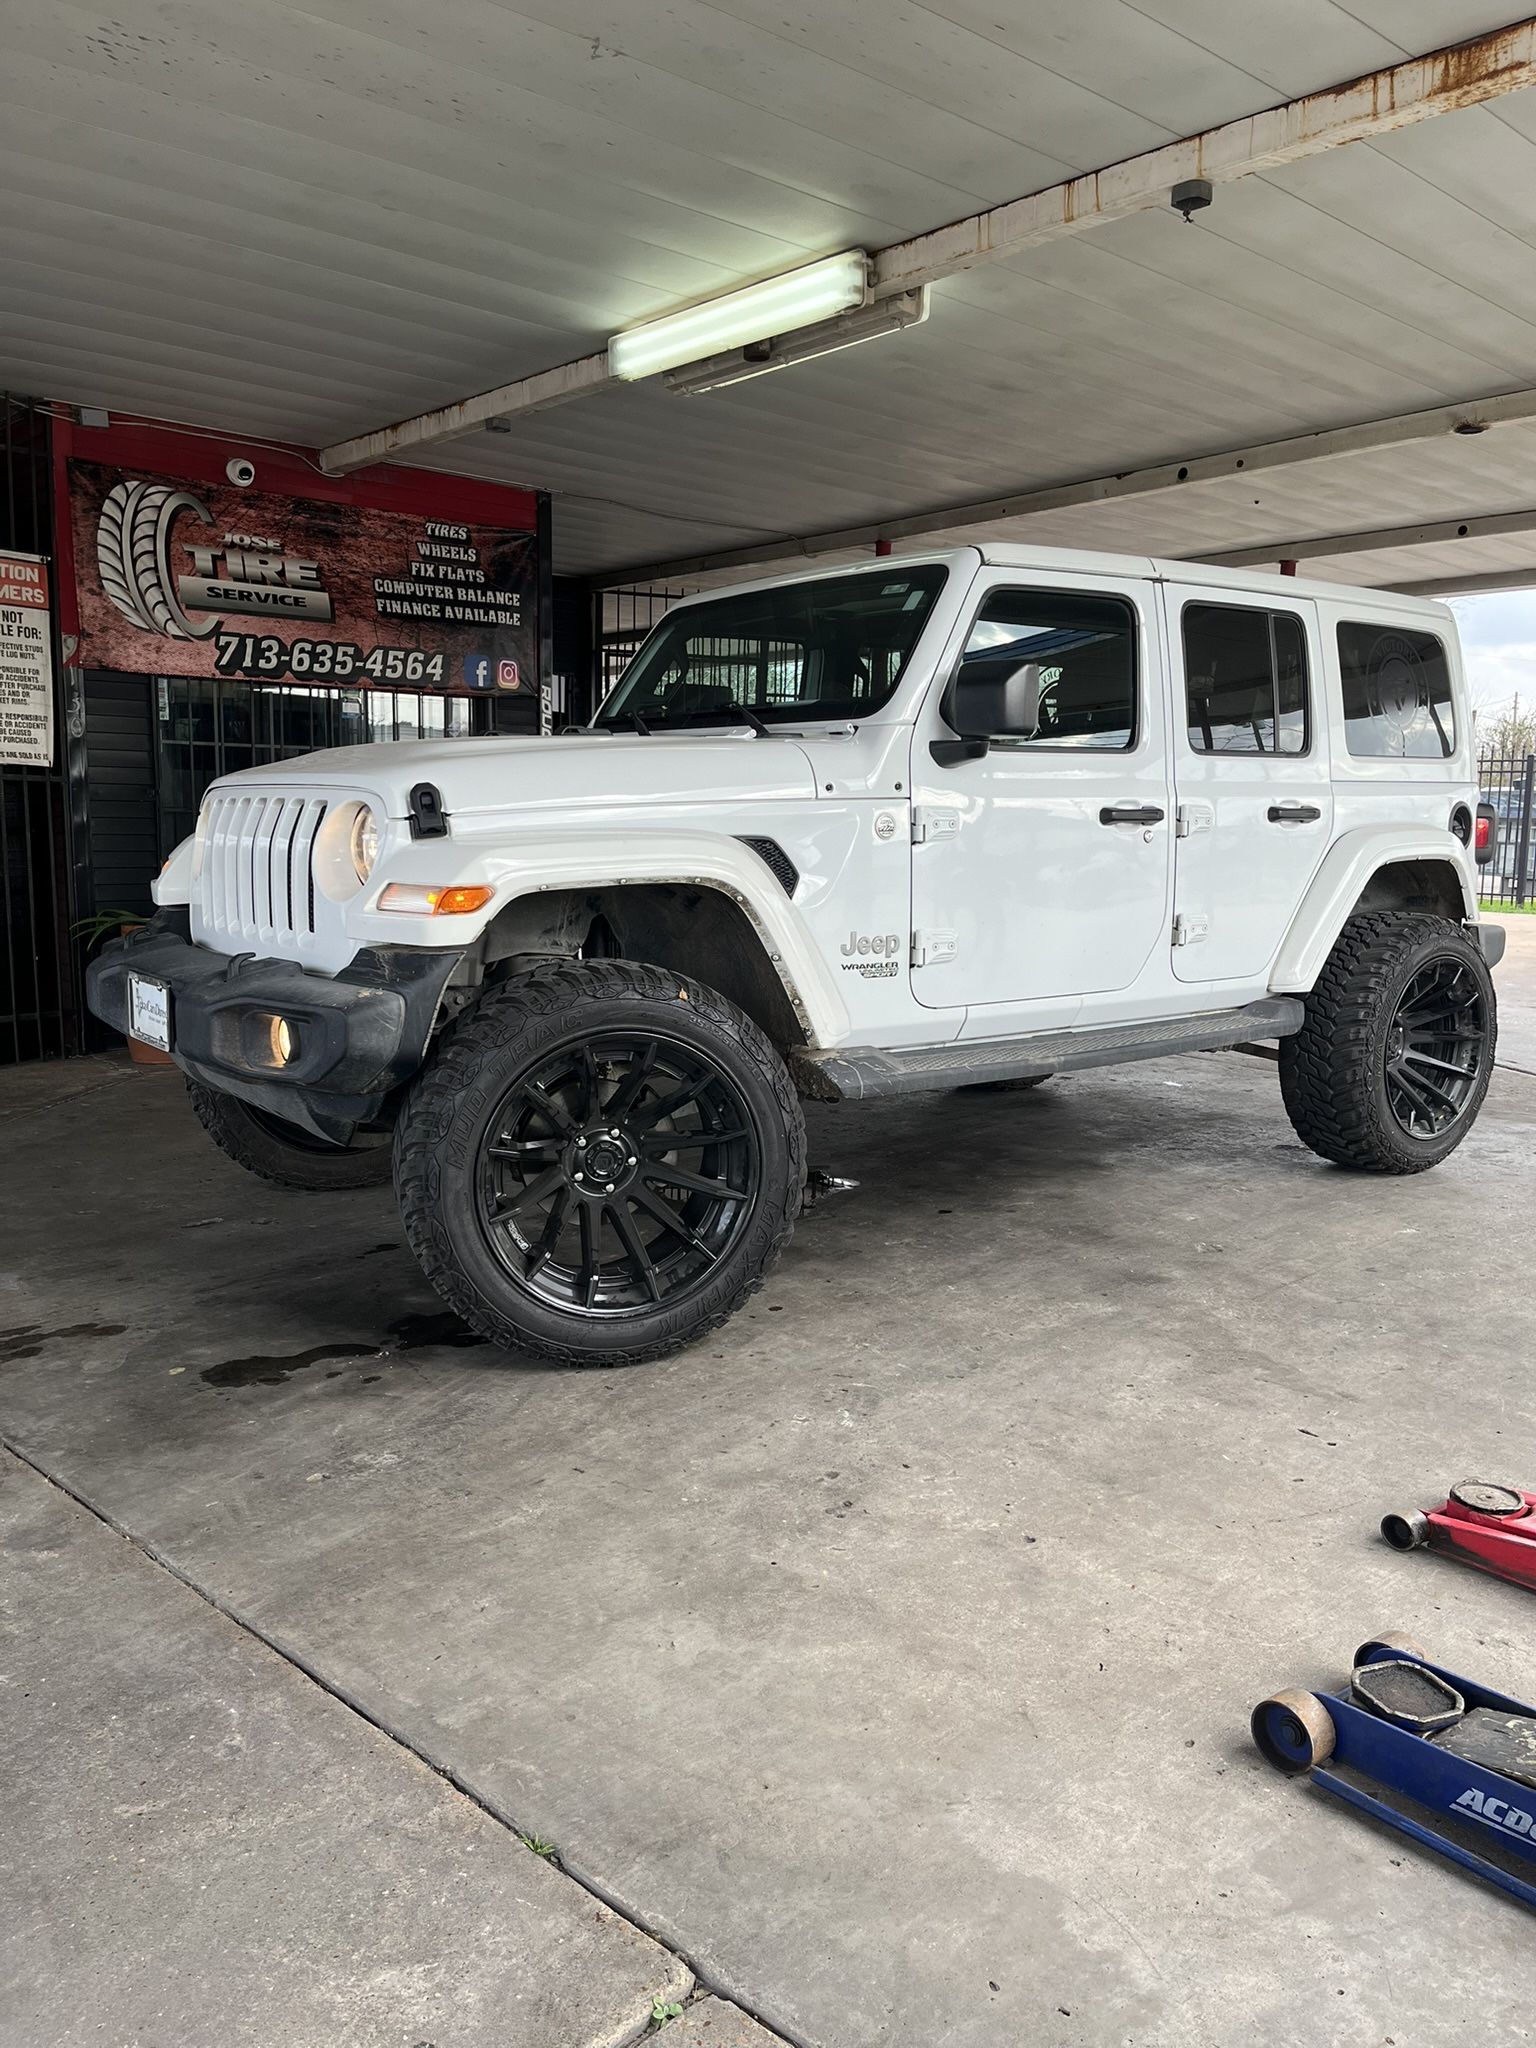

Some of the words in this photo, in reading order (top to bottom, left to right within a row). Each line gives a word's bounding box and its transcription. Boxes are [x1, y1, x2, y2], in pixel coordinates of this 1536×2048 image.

[218, 533, 282, 549] JOSE
[425, 522, 468, 540] TIRES
[417, 542, 477, 562] WHEELS
[182, 544, 321, 588] TIRE
[411, 562, 435, 577] FIX
[439, 565, 485, 583] FLATS
[206, 586, 307, 608] SERVICE
[374, 578, 453, 600] COMPUTER
[457, 588, 520, 607] BALANCE
[1, 610, 24, 624] NOT
[376, 598, 441, 617] FINANCE
[445, 606, 521, 626] AVAILABLE
[17, 625, 42, 640] FOR:
[218, 635, 444, 681] 713-635-4564
[28, 668, 40, 676] FOR
[7, 690, 20, 698] AND
[840, 931, 900, 958] Jeep
[840, 961, 899, 971] WRANGLER
[446, 1085, 488, 1171] MUD
[488, 1008, 584, 1080] TRAC
[1456, 1787, 1536, 1842] ACD
